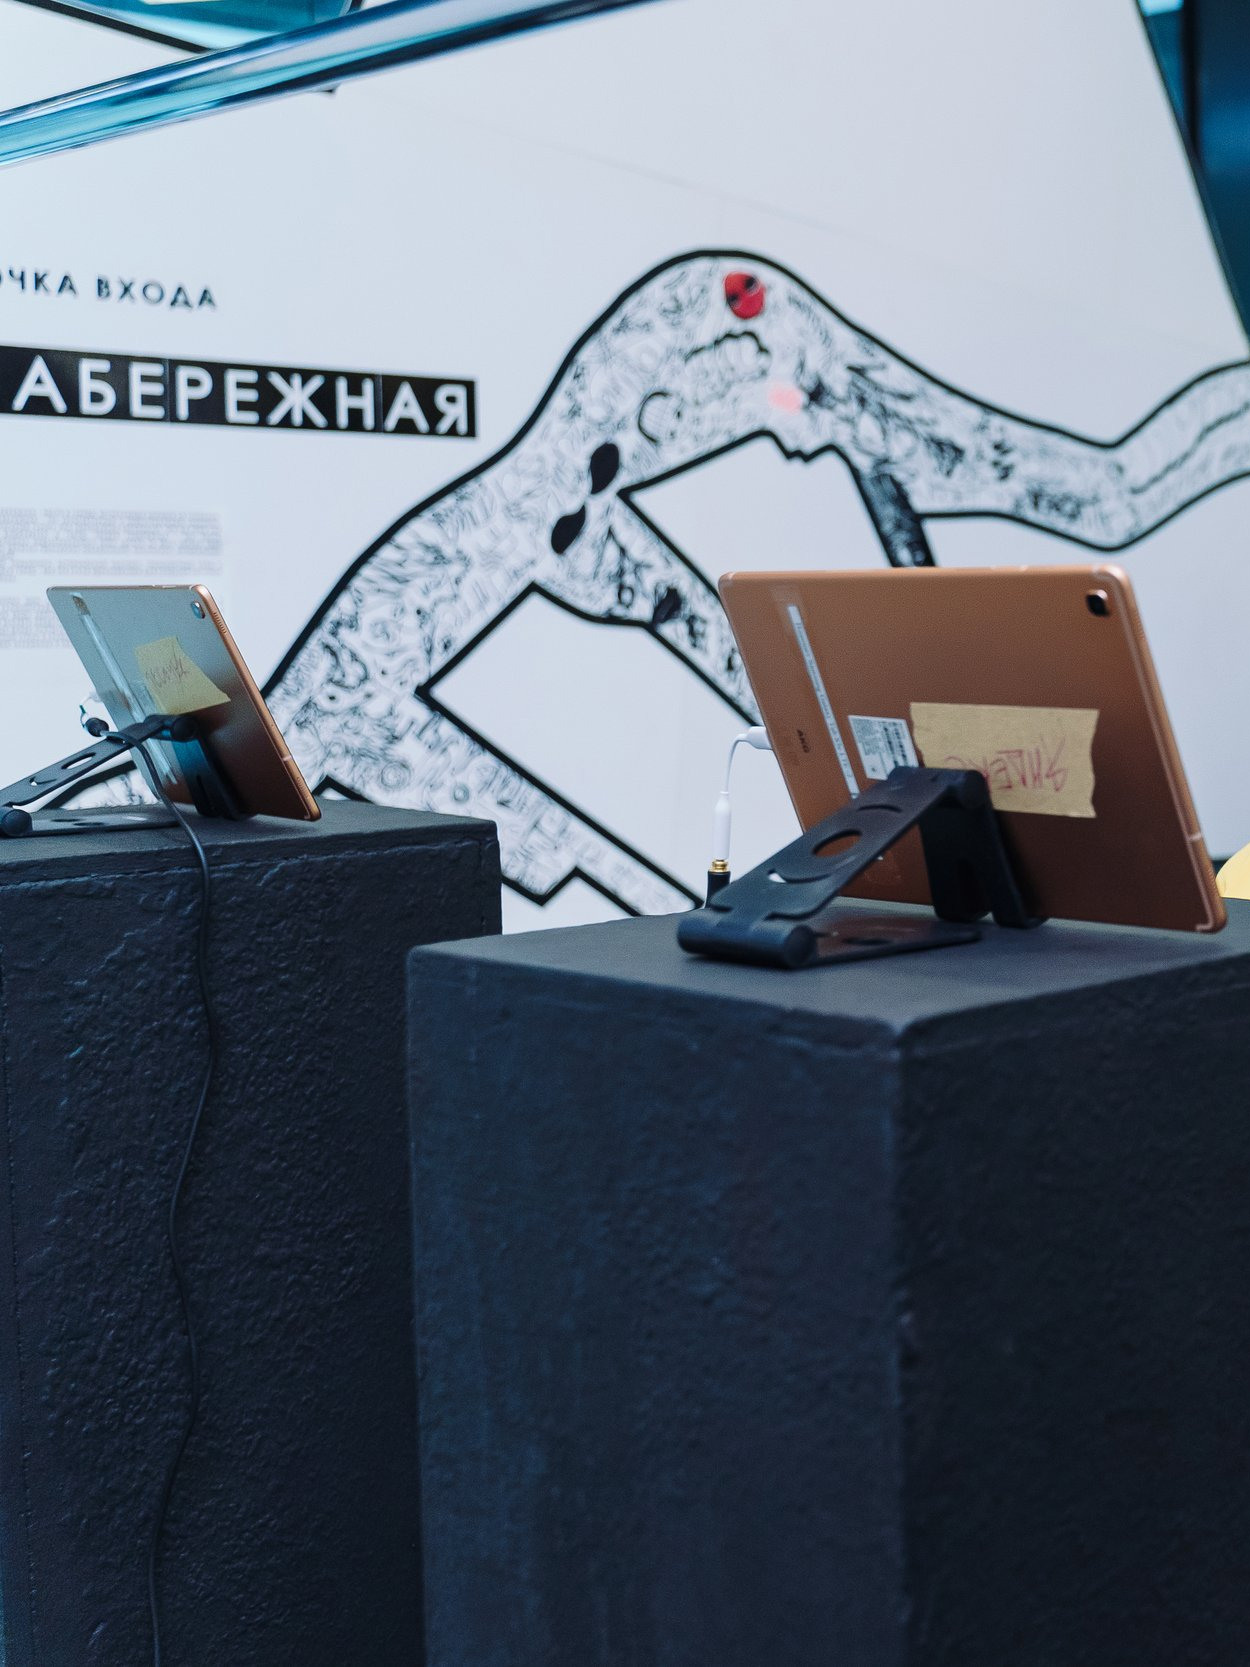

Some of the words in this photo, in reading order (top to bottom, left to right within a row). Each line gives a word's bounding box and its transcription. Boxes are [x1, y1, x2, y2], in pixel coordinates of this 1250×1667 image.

[0, 267, 77, 296] ЧКА
[97, 275, 216, 312] ВХОДА
[12, 354, 468, 435] АБЕРЕЖНАЯ
